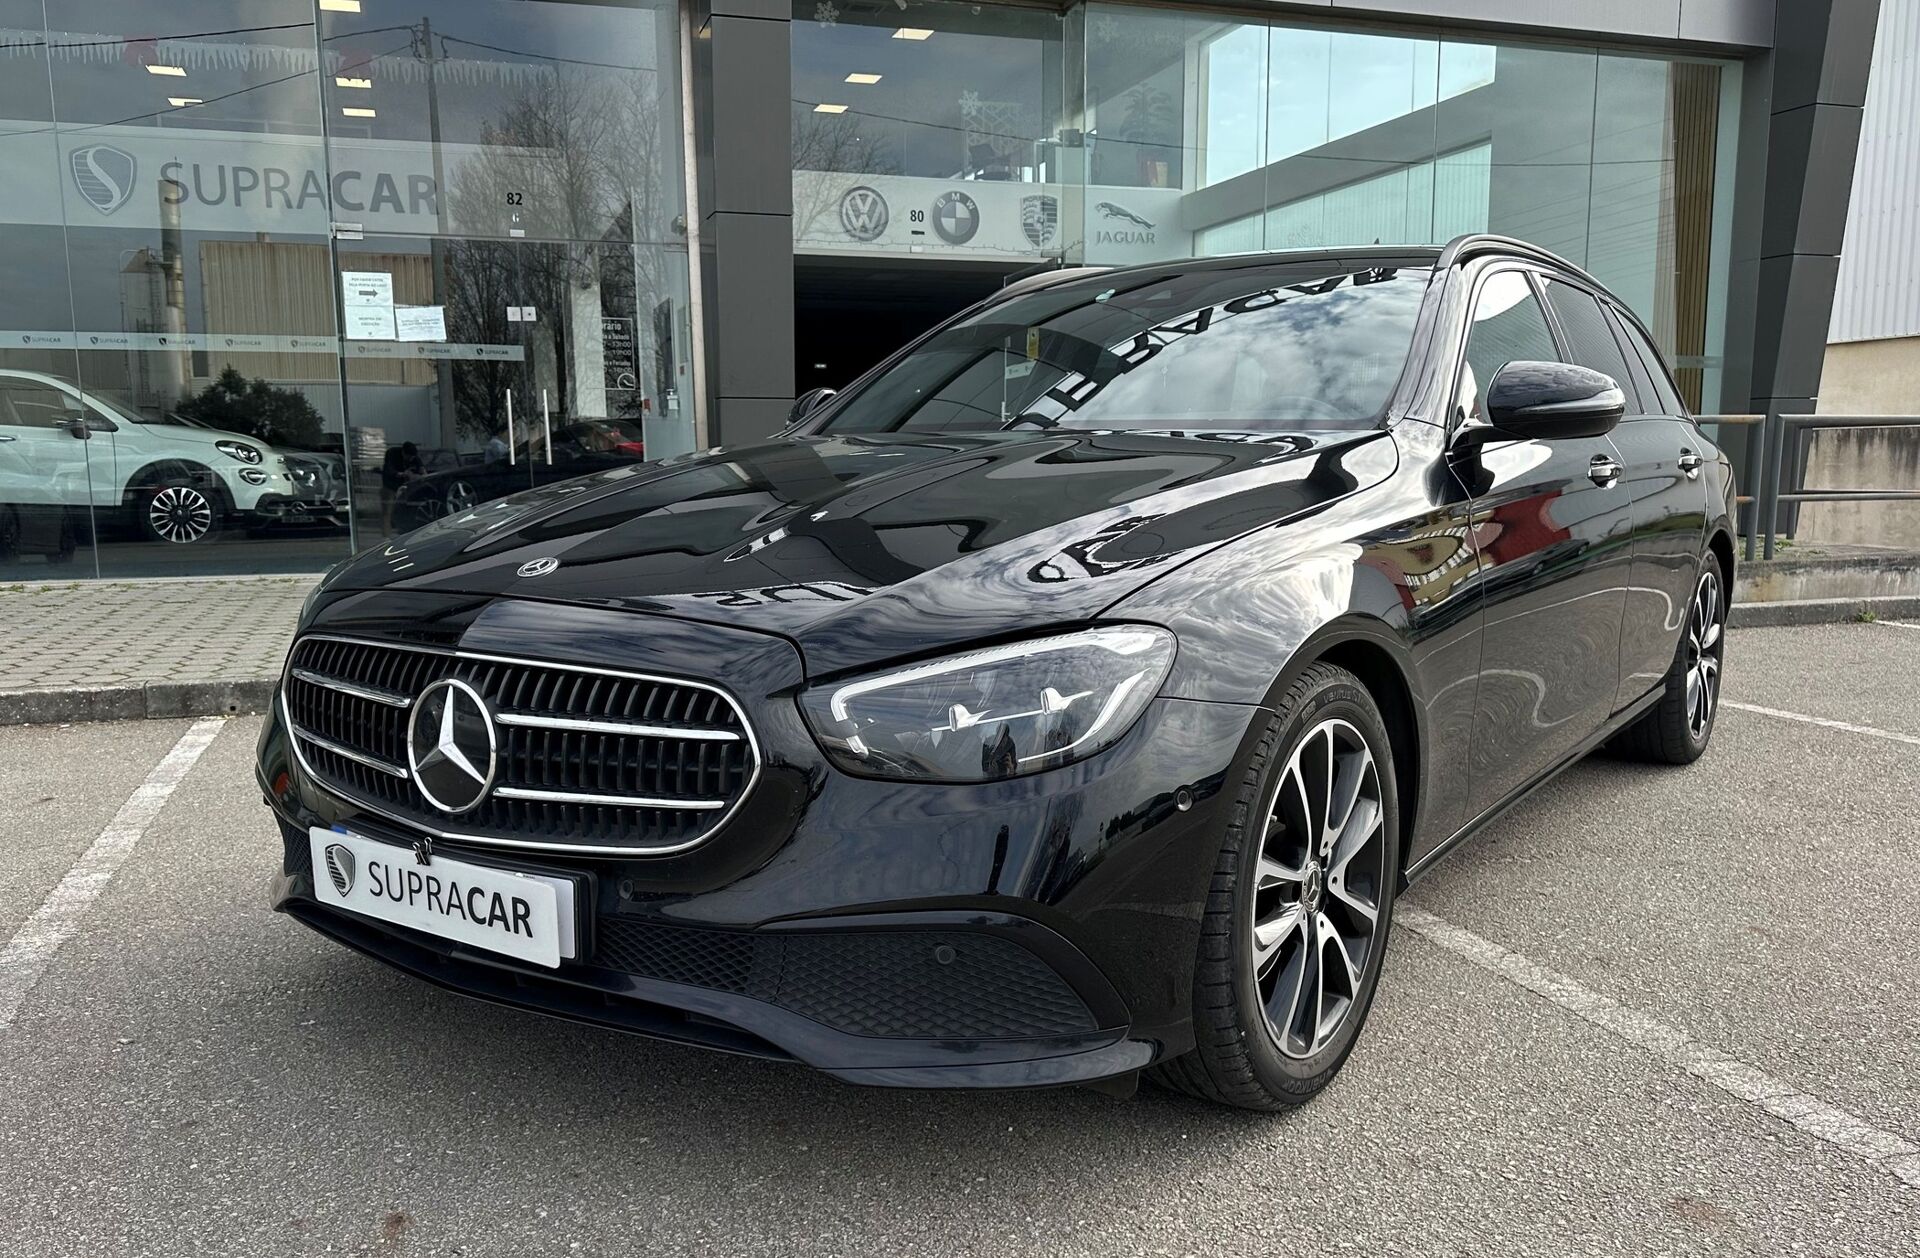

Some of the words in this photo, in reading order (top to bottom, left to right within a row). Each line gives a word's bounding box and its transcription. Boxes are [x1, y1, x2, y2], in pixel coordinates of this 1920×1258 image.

[159, 161, 440, 215] SUPRACAR
[506, 192, 523, 206] 82
[910, 209, 925, 222] 80
[1095, 231, 1156, 246] JAGUAR
[602, 320, 622, 331] rário
[368, 861, 534, 938] SUPRACAR
